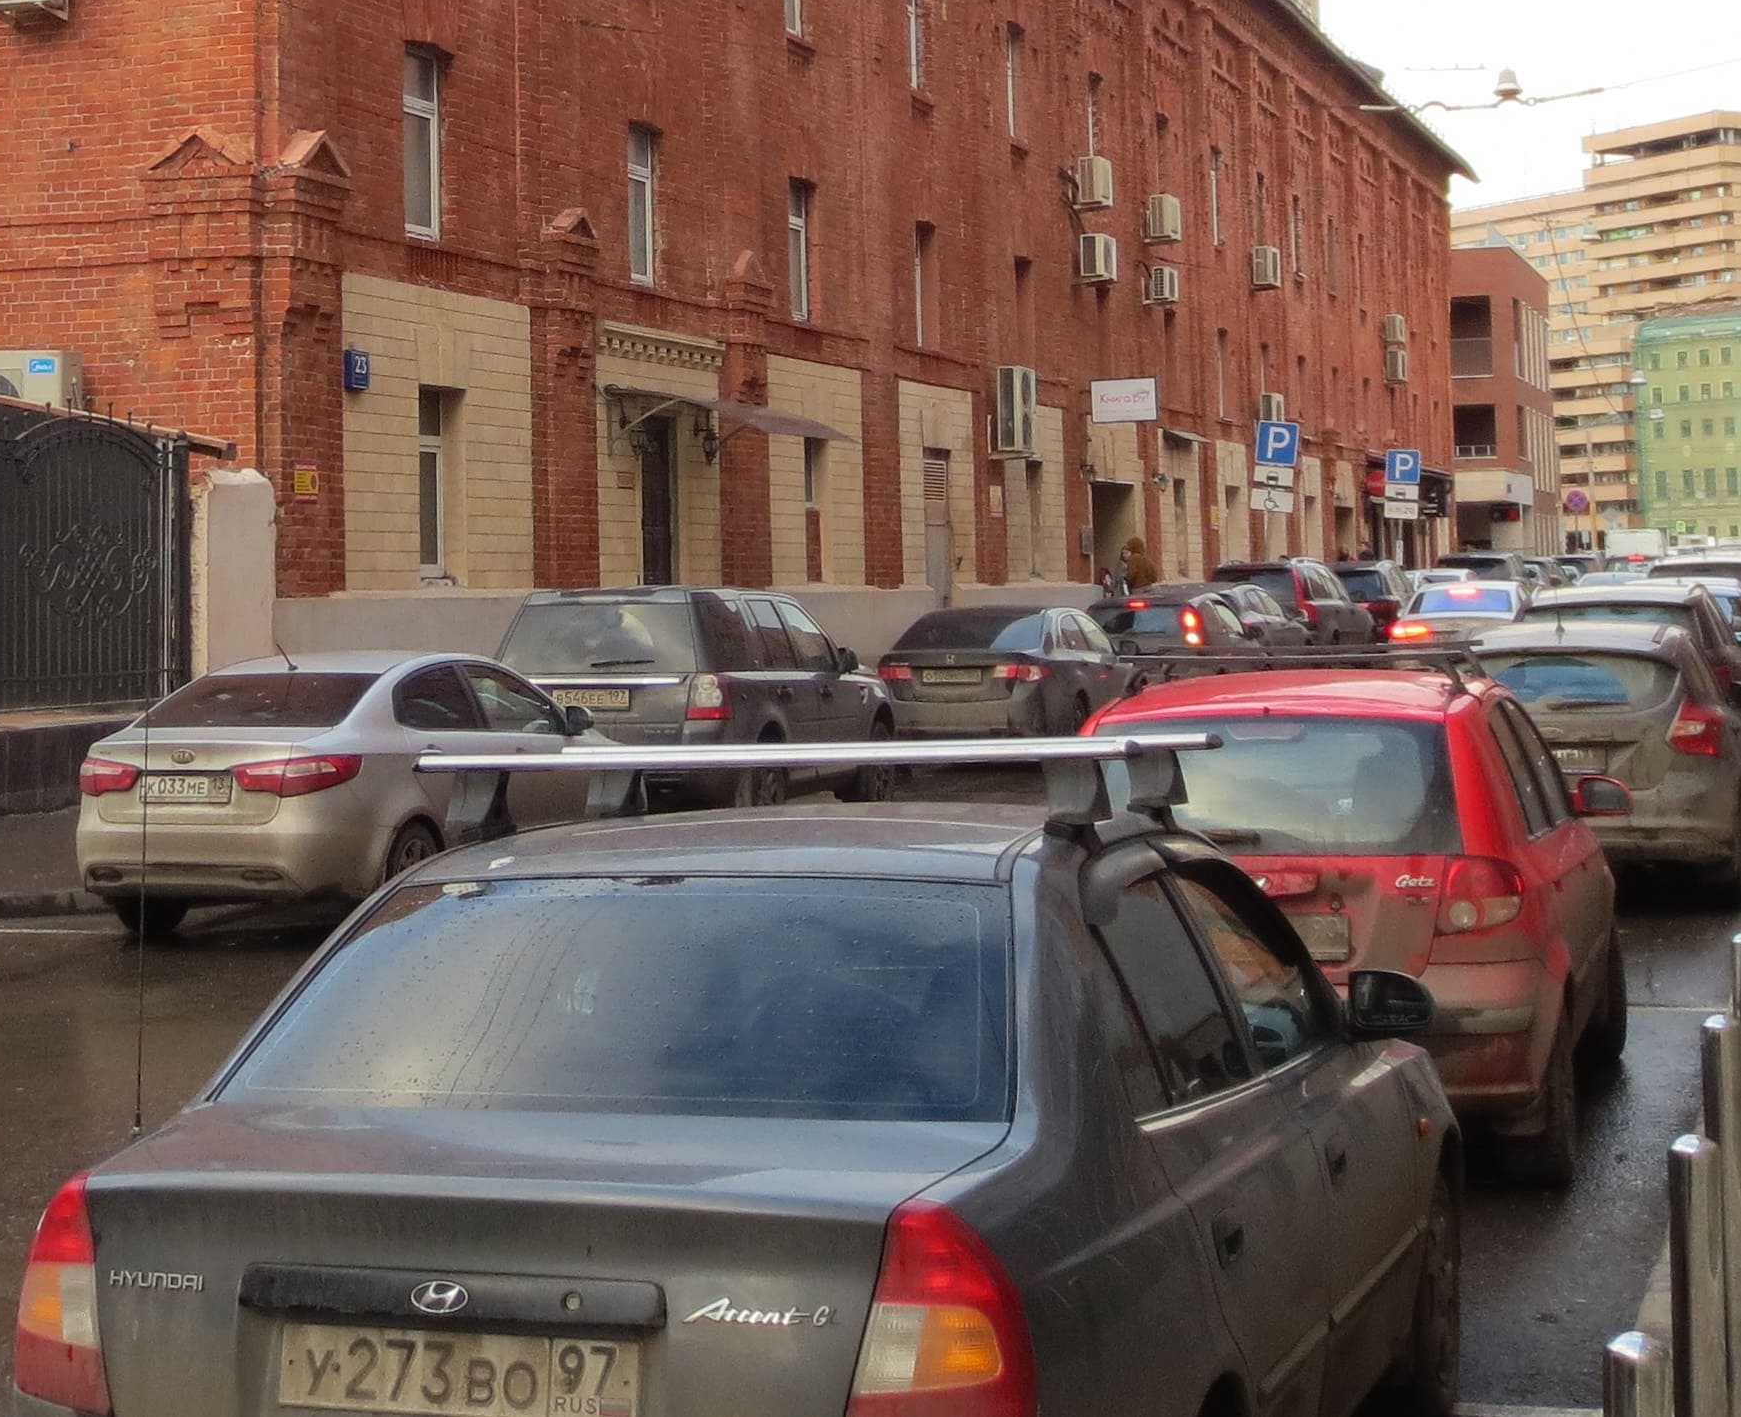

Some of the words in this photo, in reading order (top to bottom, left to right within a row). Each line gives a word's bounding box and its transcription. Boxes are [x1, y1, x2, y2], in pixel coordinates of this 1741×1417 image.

[355, 356, 367, 374] 23
[1266, 426, 1291, 459] P
[1394, 453, 1414, 479] P
[1395, 874, 1436, 888] Getz
[110, 1269, 205, 1292] HYUNDAI
[682, 1296, 811, 1326] Accent
[306, 1336, 538, 1411] У273ВО
[559, 1344, 619, 1397] 97
[554, 1395, 597, 1416] RUS
